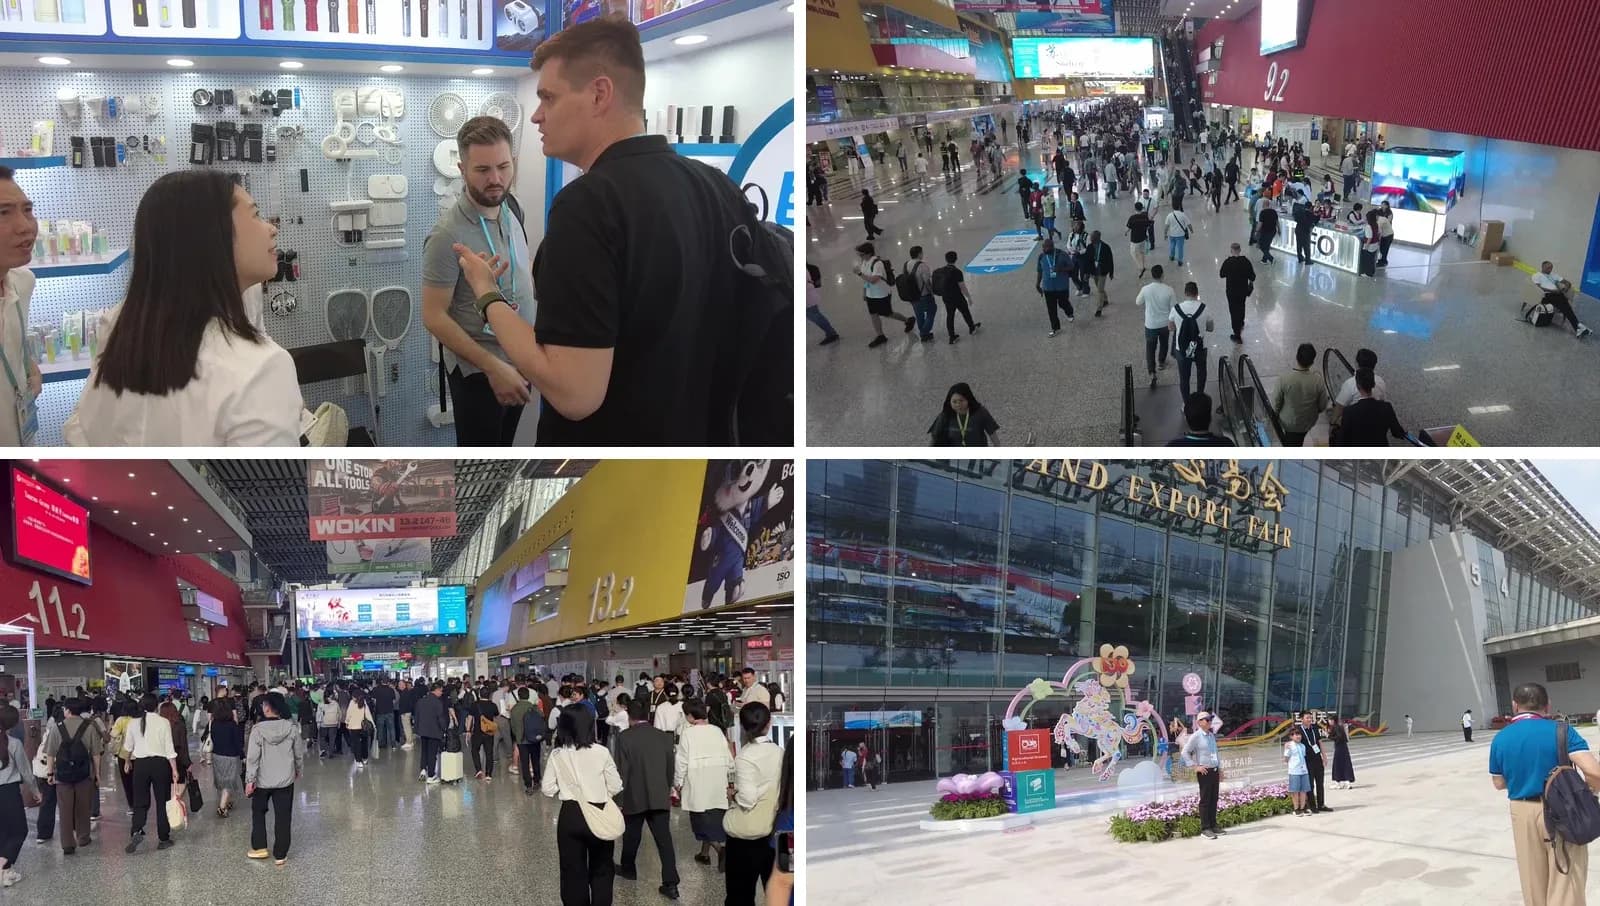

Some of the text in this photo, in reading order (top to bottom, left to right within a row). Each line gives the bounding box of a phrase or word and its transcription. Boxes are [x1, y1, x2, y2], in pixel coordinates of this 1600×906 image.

[1264, 61, 1290, 102] 9.2
[313, 470, 370, 490] ALL TOOLS
[324, 459, 374, 479] ONE STOP
[1025, 459, 1292, 549] AND EXPORT FAIR
[315, 517, 396, 535] WOKIN
[726, 513, 746, 544] Welcome
[776, 570, 791, 582] ISO
[1470, 562, 1509, 598] 5 4
[28, 580, 91, 641] 11.2
[588, 571, 635, 624] 13.2
